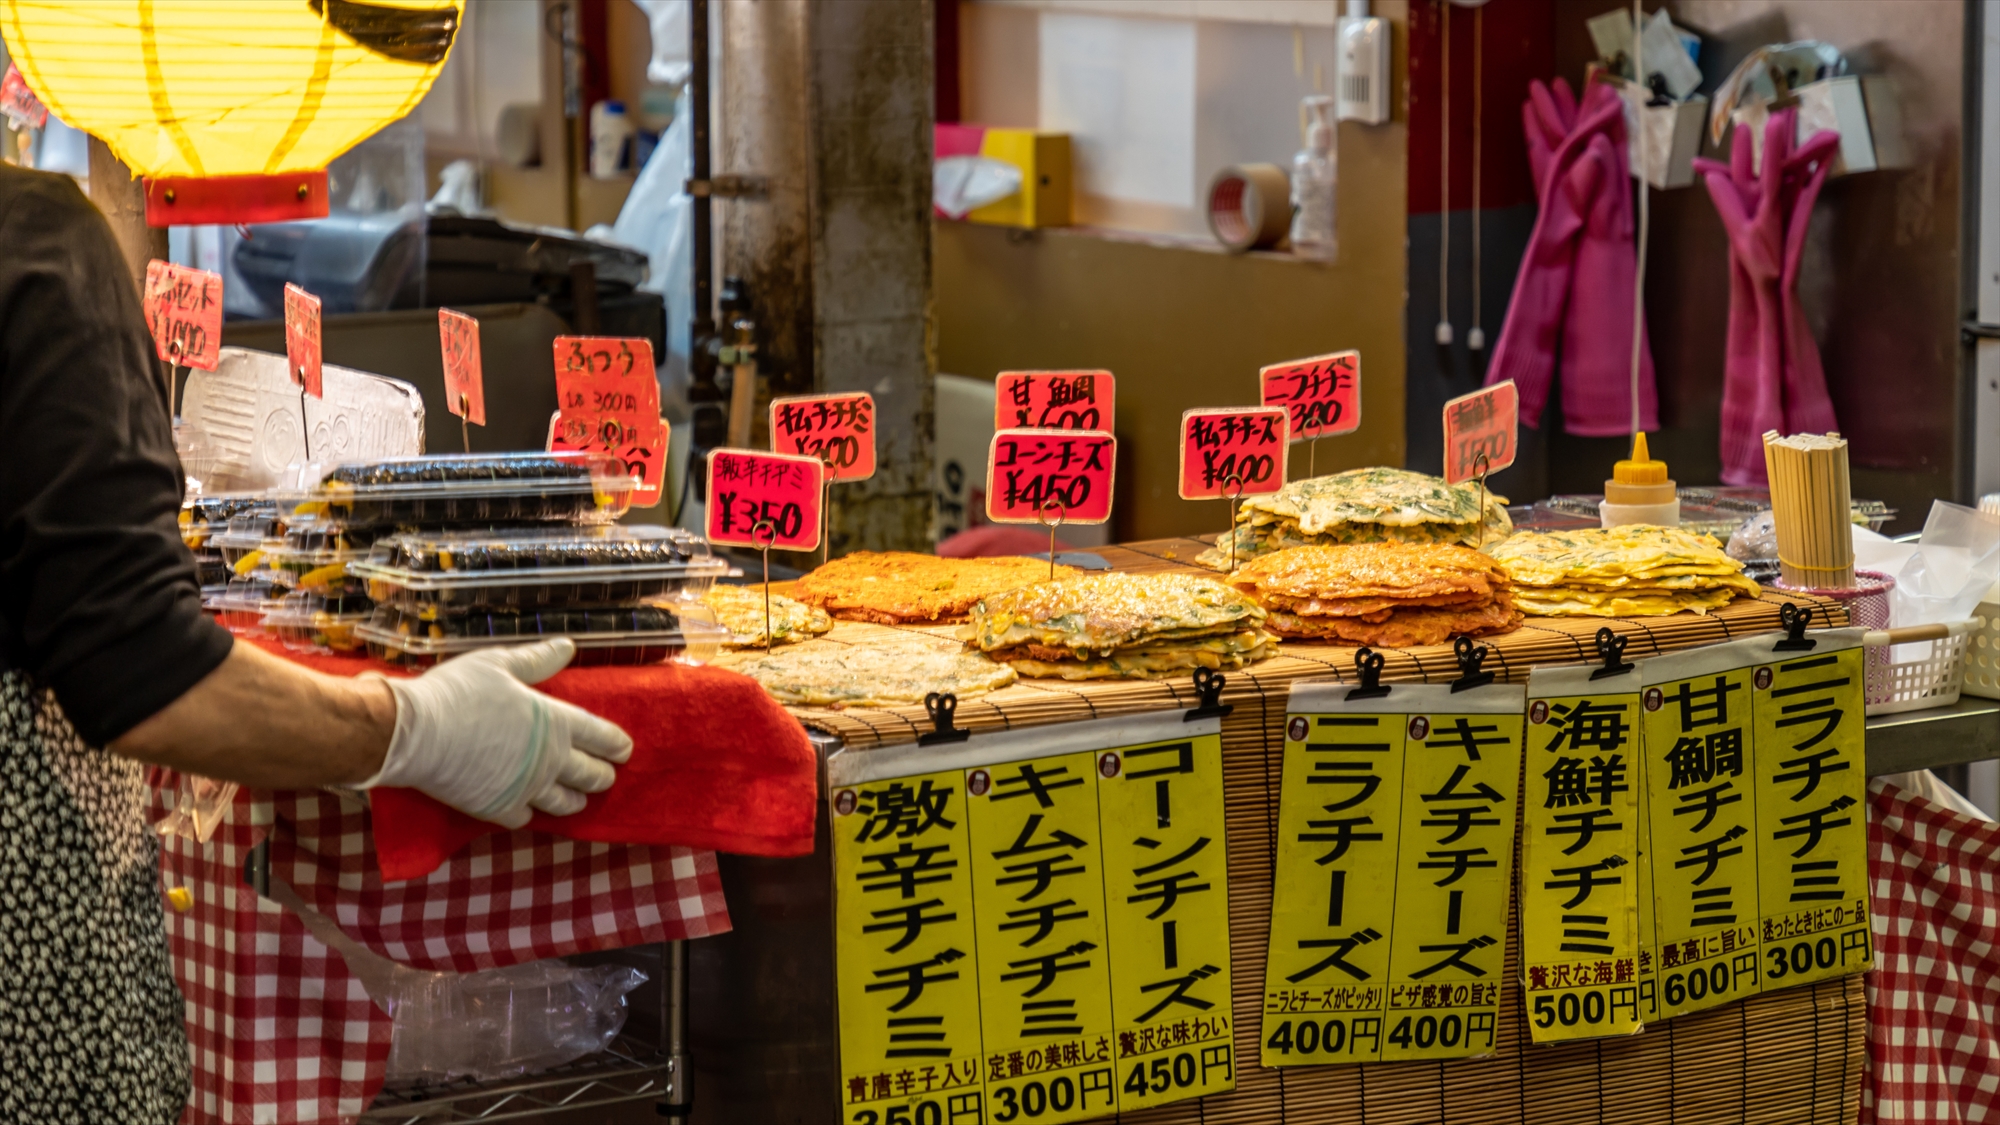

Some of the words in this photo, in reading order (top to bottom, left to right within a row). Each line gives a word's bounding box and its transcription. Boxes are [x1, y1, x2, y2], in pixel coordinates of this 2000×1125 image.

[566, 340, 634, 376] ふつう
[1008, 375, 1095, 408] 甘鯛
[1277, 400, 1342, 433] 300
[715, 455, 803, 490] 激辛チヂミ
[995, 439, 1114, 472] コーンチーズ
[1202, 449, 1274, 489] ¥400
[1003, 469, 1091, 511] ¥450
[719, 491, 803, 539] ¥350
[1771, 655, 1858, 903] ニラチヂミ
[1664, 675, 1748, 928] 甘鯛チヂミ
[1543, 700, 1629, 955] 海鮮チヂミ
[1285, 717, 1391, 984] ニラチーズ
[1408, 718, 1511, 980] キムチチーズ
[989, 764, 1099, 1037] キムチチヂミ
[1123, 742, 1222, 1024] コーンチーズ
[854, 778, 966, 1059] 激辛チヂミ
[1762, 900, 1867, 942] 迷ったときはこの一品
[1661, 926, 1755, 968] 最高に旨い
[1766, 928, 1870, 979] 300円
[1390, 982, 1498, 1008] ピザ感覚の旨さ
[1528, 958, 1635, 991] 贅沢な海鮮
[1664, 951, 1758, 1007] 600円
[1266, 986, 1383, 1012] ニラとチーズがピッタリ
[1534, 987, 1638, 1029] 500円
[1118, 1016, 1228, 1058] 贅沢な味わい
[1267, 1017, 1382, 1055] 400円
[1388, 1012, 1496, 1049] 400円
[988, 1036, 1111, 1080] 定番の美味しさ
[1124, 1044, 1232, 1098] 450円
[847, 1058, 977, 1103] 青唐辛子入り
[993, 1067, 1115, 1124] 300円
